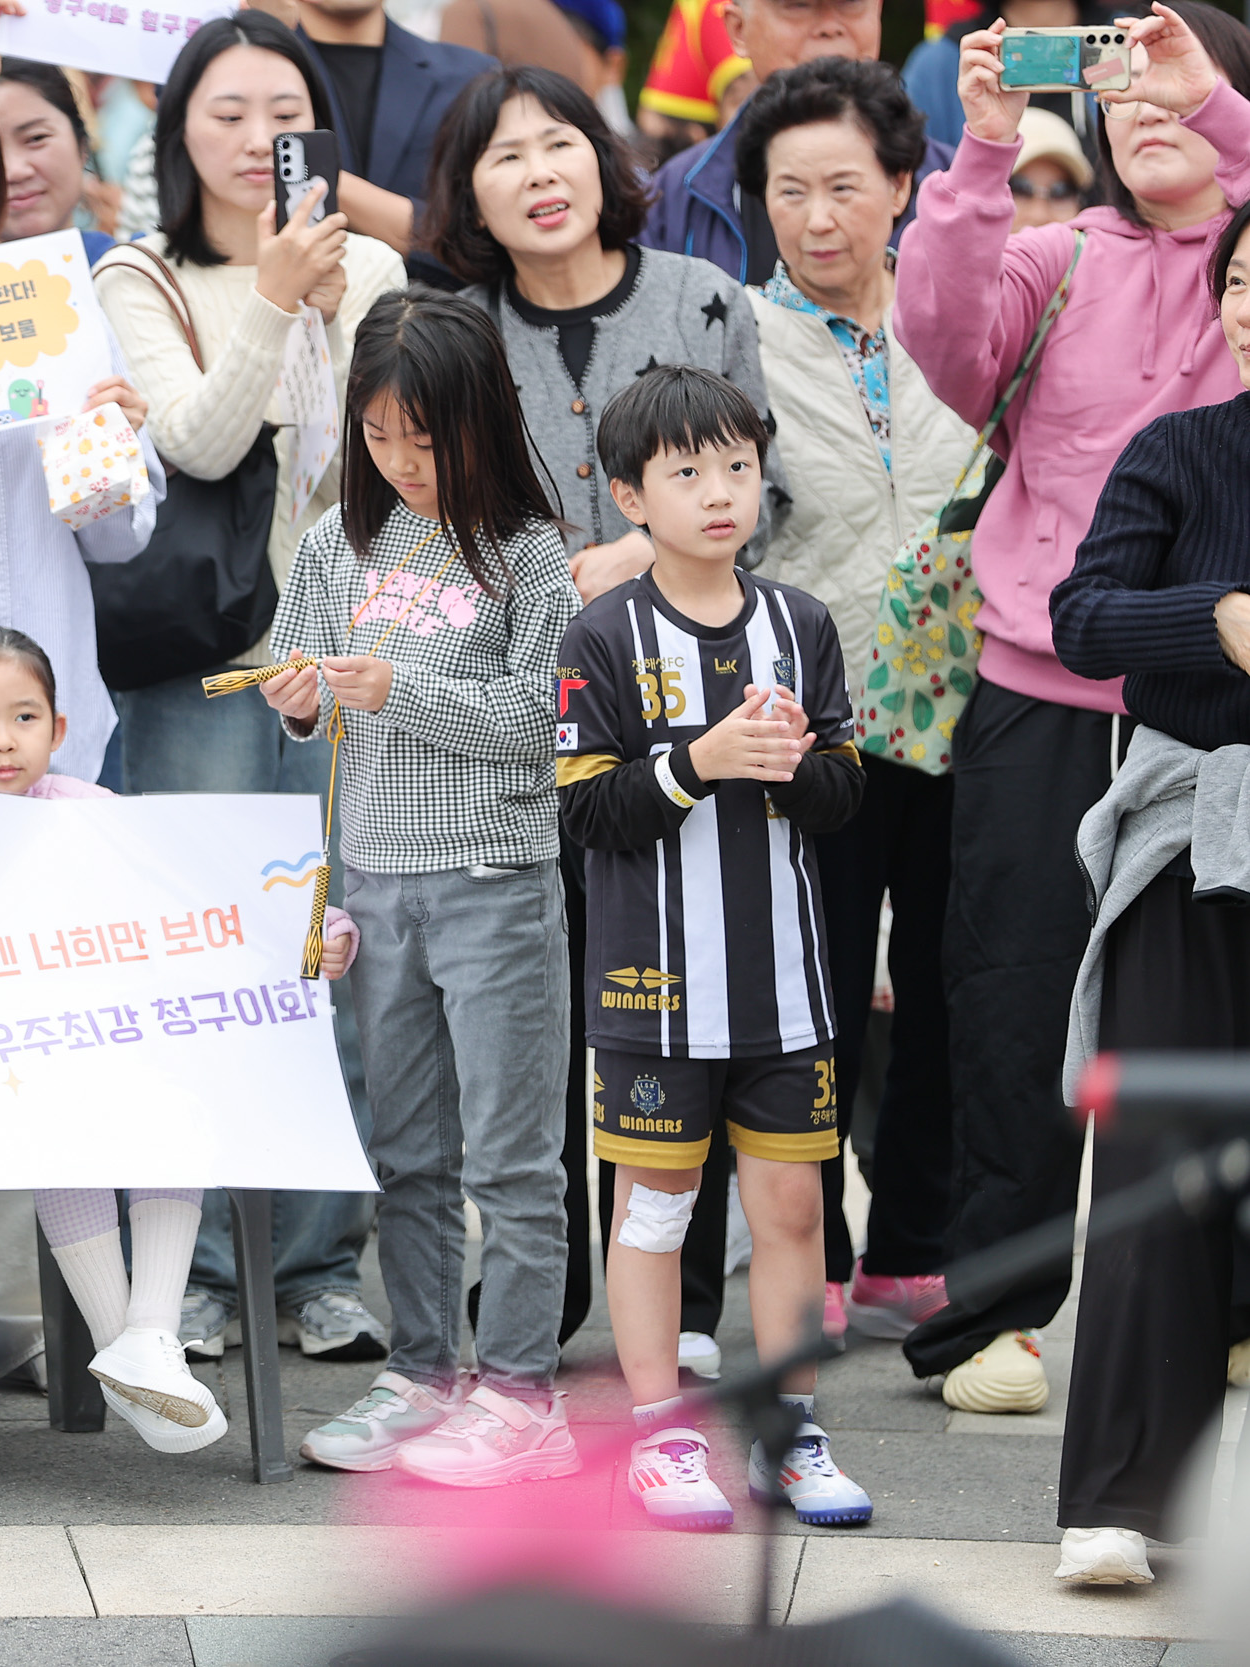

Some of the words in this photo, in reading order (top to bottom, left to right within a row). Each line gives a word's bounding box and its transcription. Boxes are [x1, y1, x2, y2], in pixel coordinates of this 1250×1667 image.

[365, 569, 443, 608] LOVE
[635, 671, 687, 720] 35
[28, 920, 150, 971] 너희만
[160, 904, 245, 957] 보여
[150, 979, 318, 1036] 청구이화
[601, 990, 682, 1011] WINNERS
[619, 1114, 683, 1134] WINNERS
